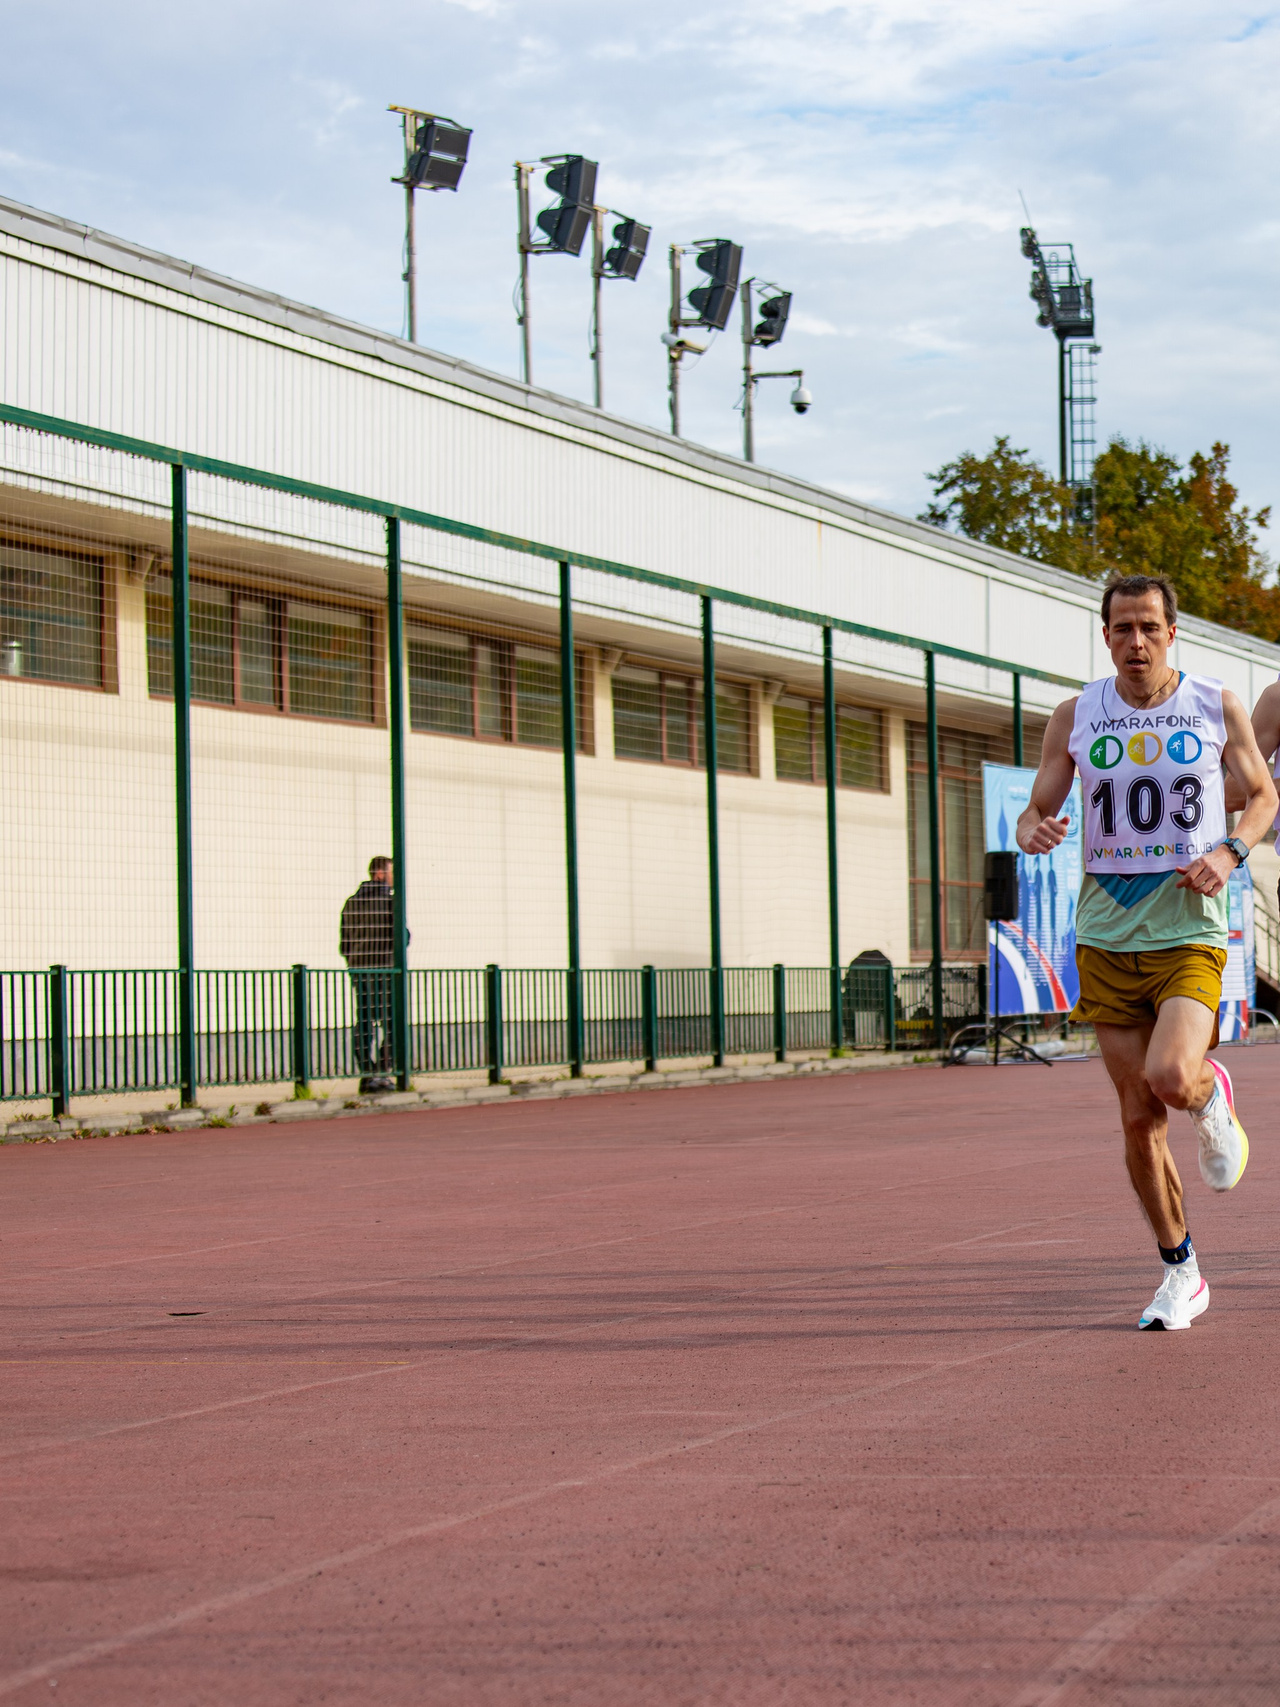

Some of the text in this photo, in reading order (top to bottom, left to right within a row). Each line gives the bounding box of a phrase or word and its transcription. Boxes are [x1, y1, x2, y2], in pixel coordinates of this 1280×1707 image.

[1090, 714, 1202, 734] VMARAFONE
[1090, 773, 1205, 838] 103
[1093, 841, 1213, 860] VMARAFONE.CLUB
